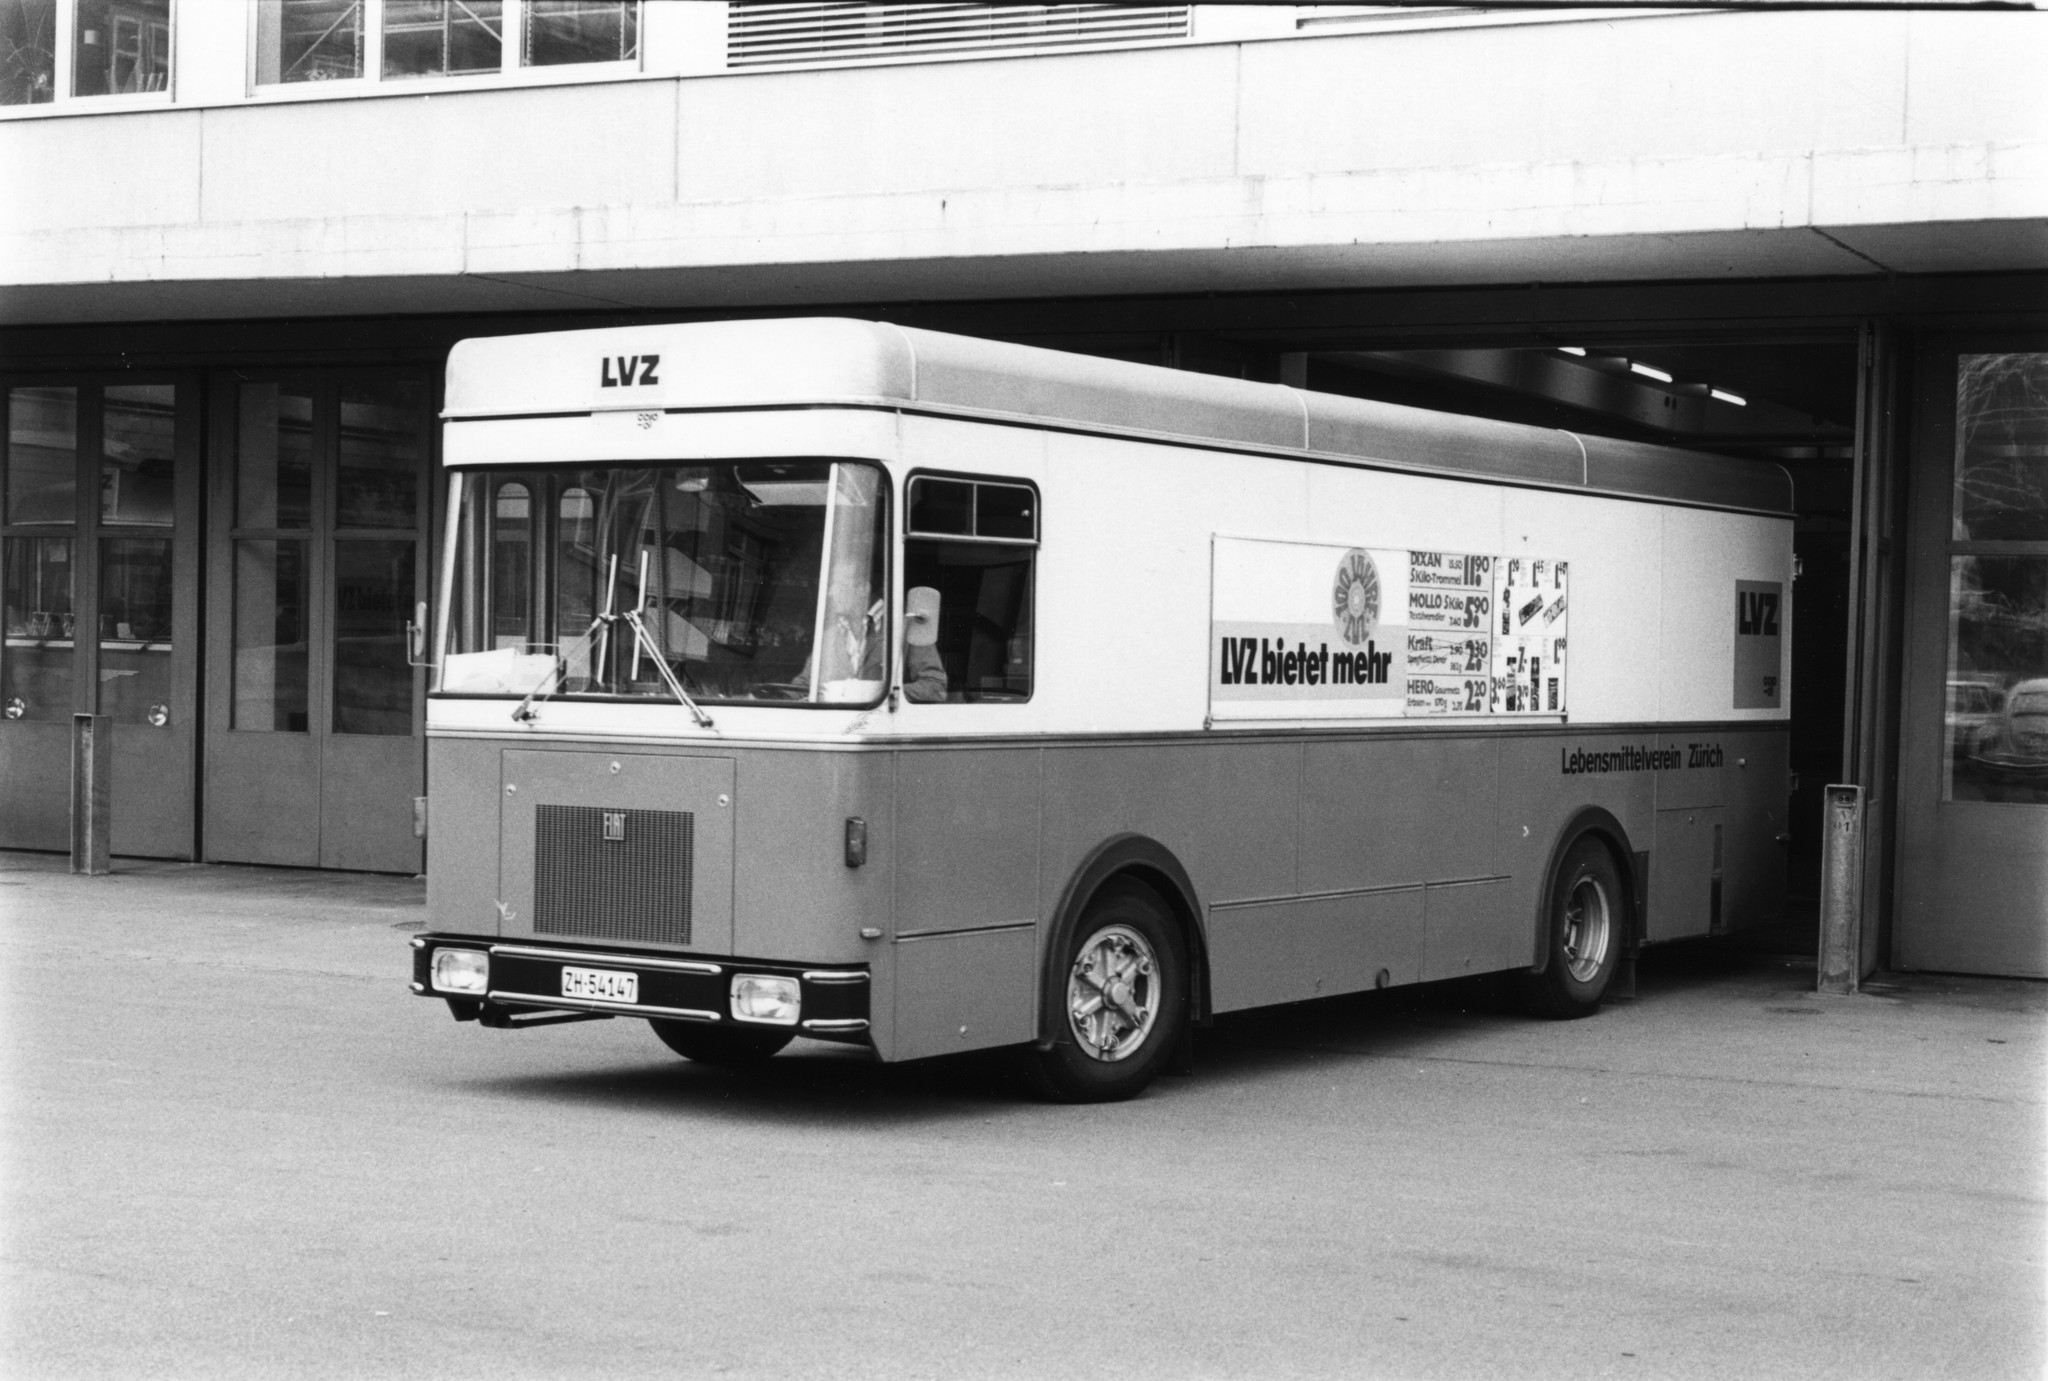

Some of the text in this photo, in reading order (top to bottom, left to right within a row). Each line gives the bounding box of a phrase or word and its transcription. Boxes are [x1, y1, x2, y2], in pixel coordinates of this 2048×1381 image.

[601, 354, 660, 388] LVZ
[1410, 551, 1442, 567] DIXAN
[1409, 592, 1442, 610] MOLLO
[1738, 591, 1778, 636] LVZ
[1407, 634, 1433, 652] Kraft
[1221, 636, 1392, 686] LVZ bietet mehr
[1407, 679, 1434, 695] HERO
[1562, 743, 1723, 774] Lebensmittelverein Zürich
